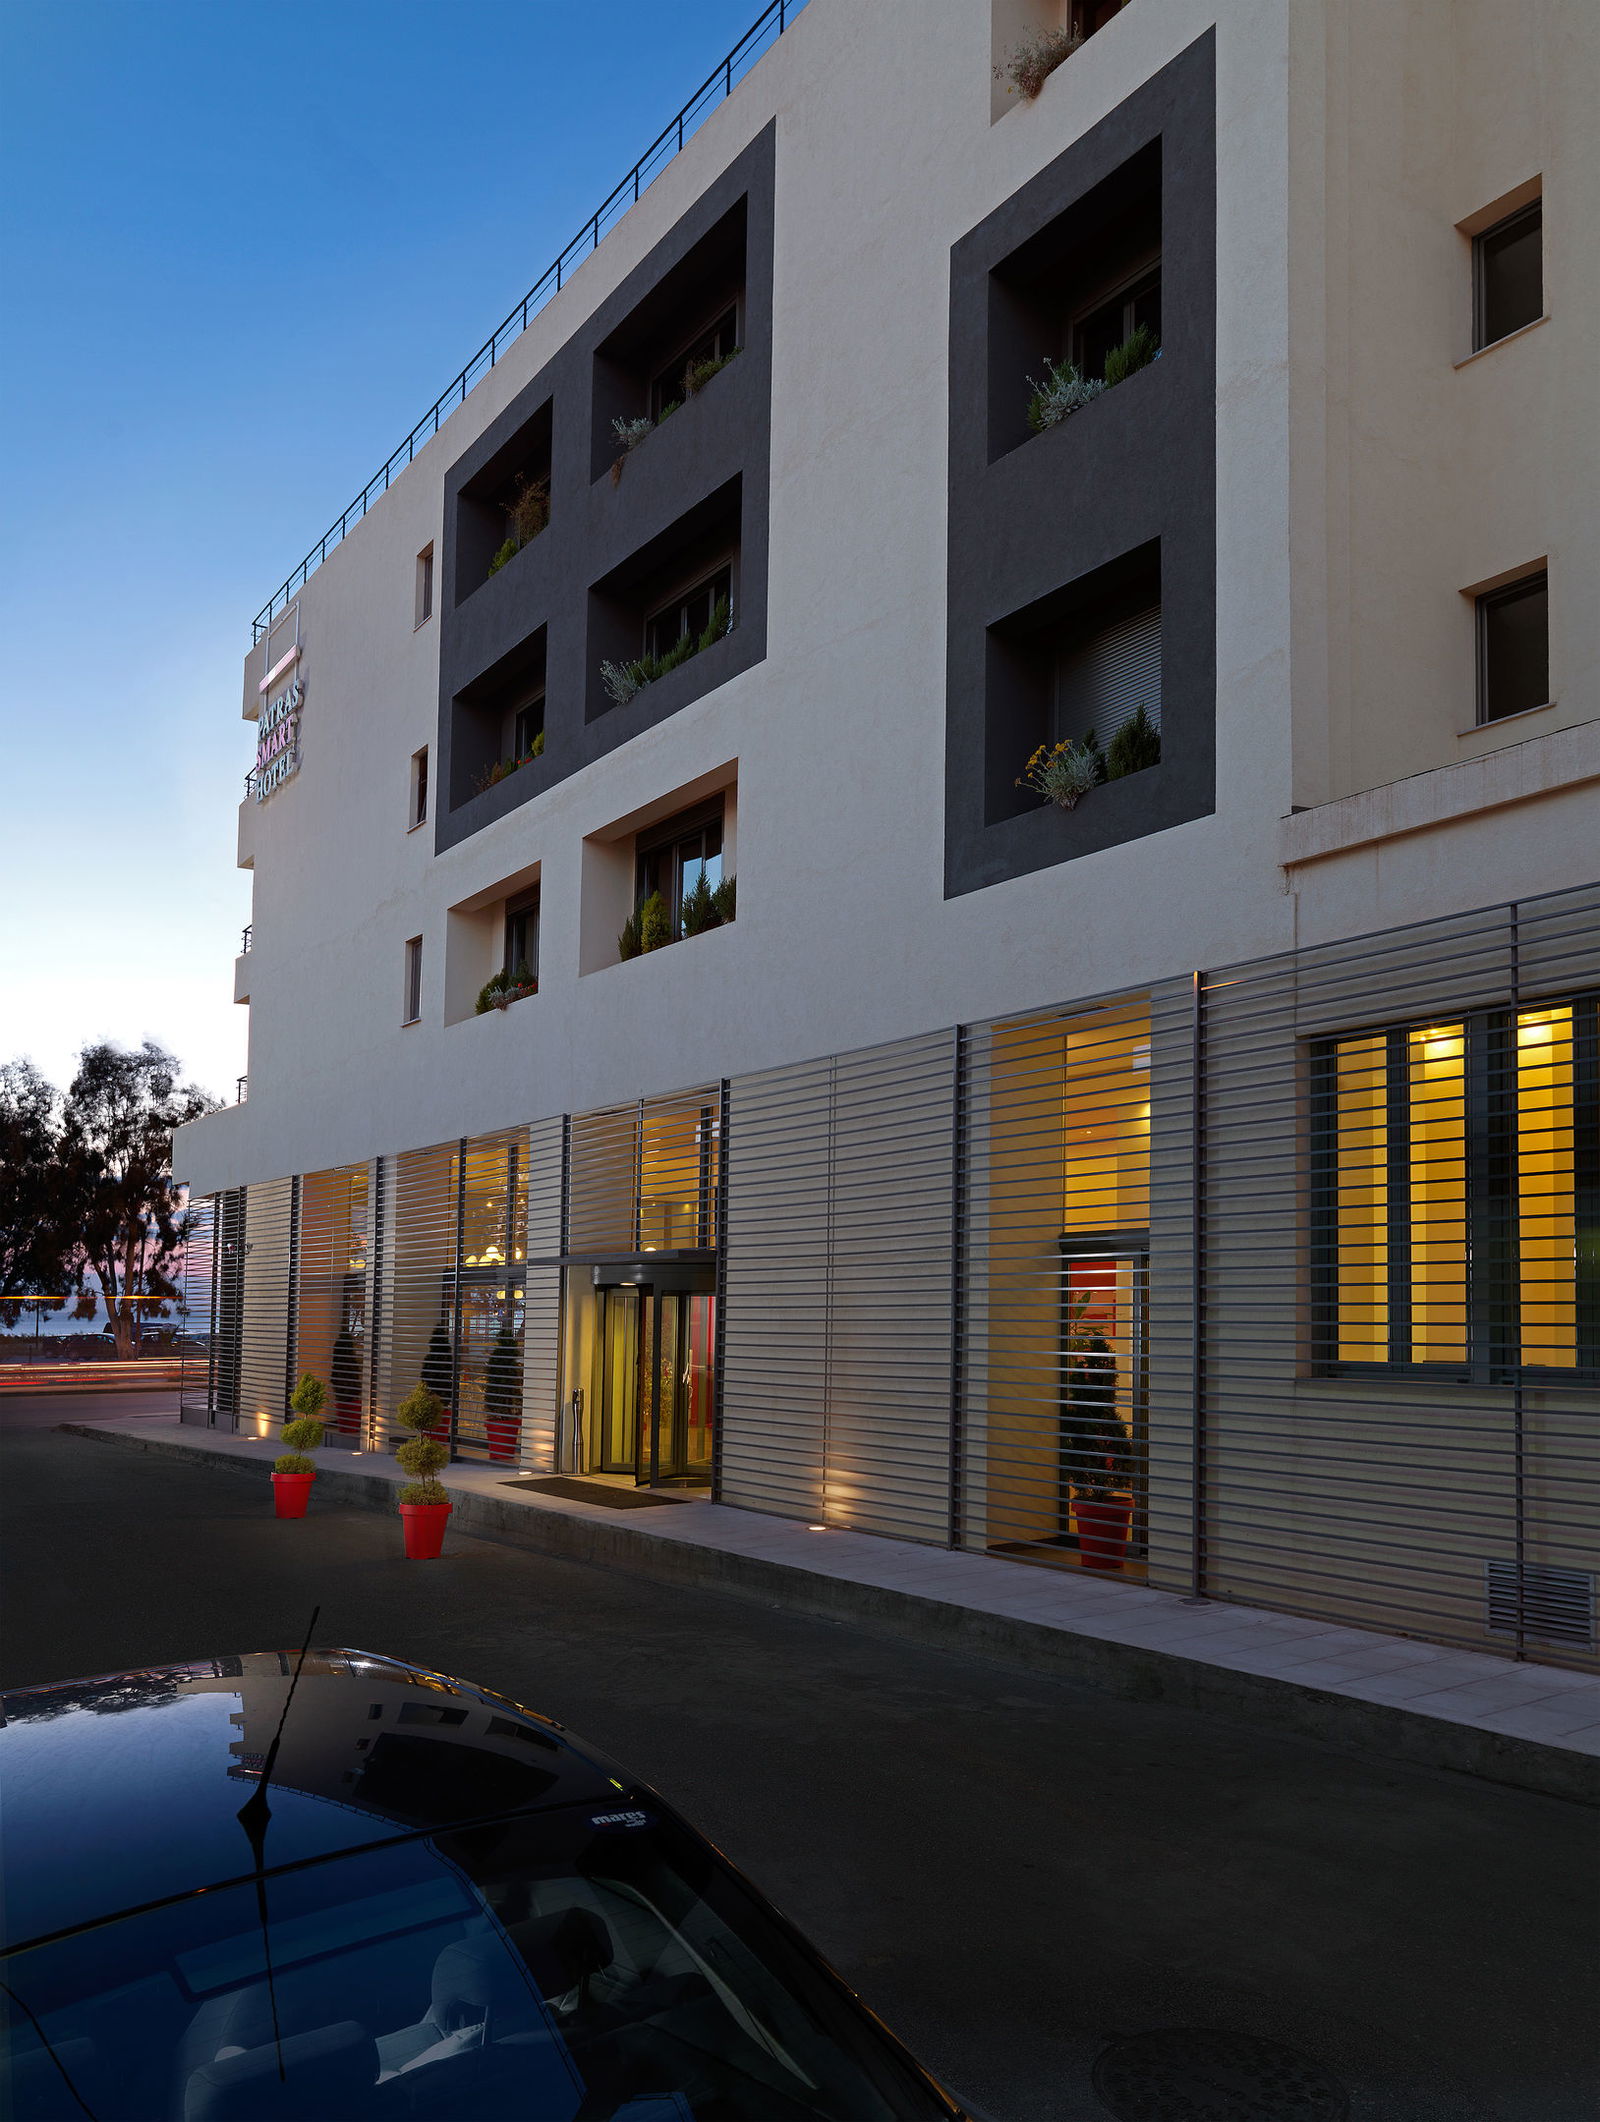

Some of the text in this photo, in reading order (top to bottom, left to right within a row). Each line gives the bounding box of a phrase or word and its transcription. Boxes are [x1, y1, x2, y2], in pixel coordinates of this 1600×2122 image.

[258, 678, 301, 740] PATRAS
[255, 714, 295, 772] SMART
[256, 749, 295, 804] HOTEL
